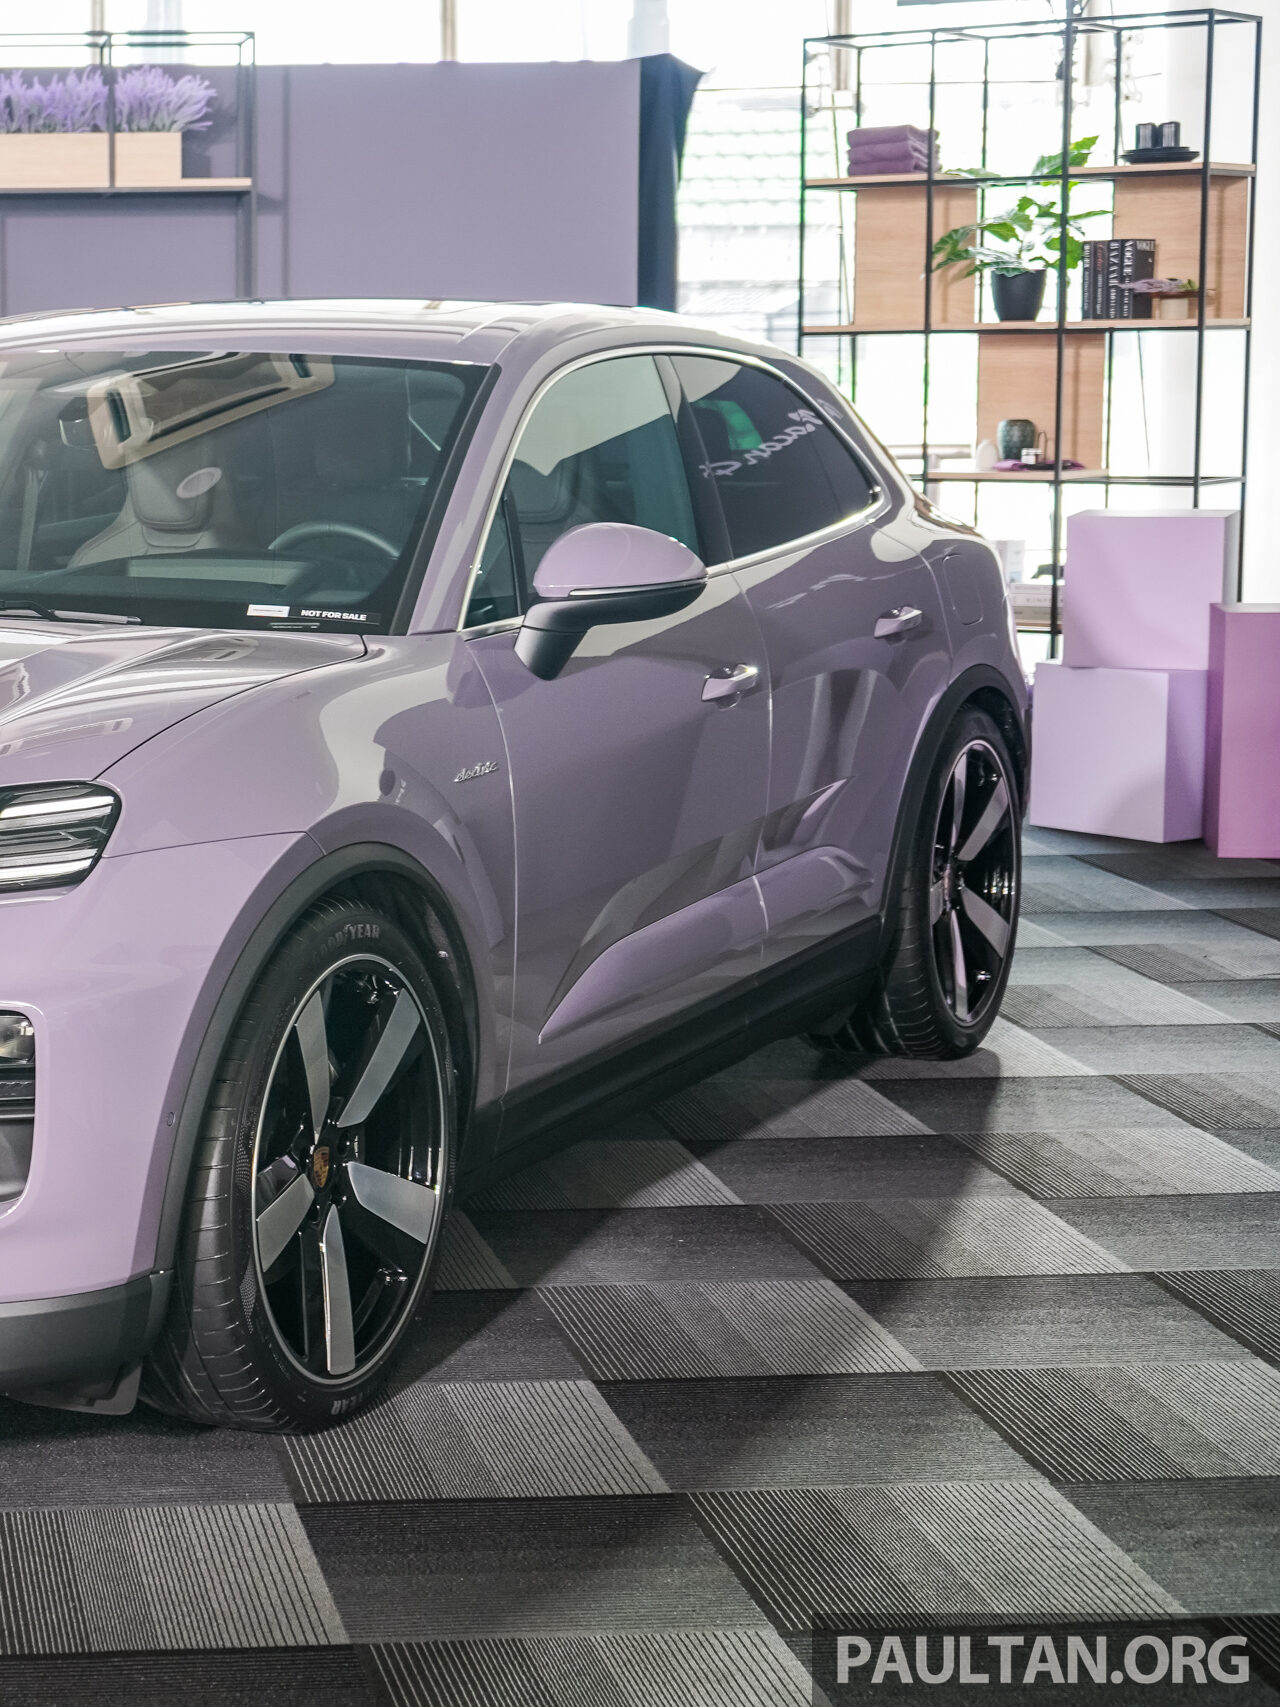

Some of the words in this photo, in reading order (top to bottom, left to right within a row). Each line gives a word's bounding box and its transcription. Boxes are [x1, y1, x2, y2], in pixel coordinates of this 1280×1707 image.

[1123, 241, 1133, 276] VOGUE
[301, 609, 321, 617] NOT
[322, 611, 341, 619] FOR
[342, 613, 367, 621] SALE
